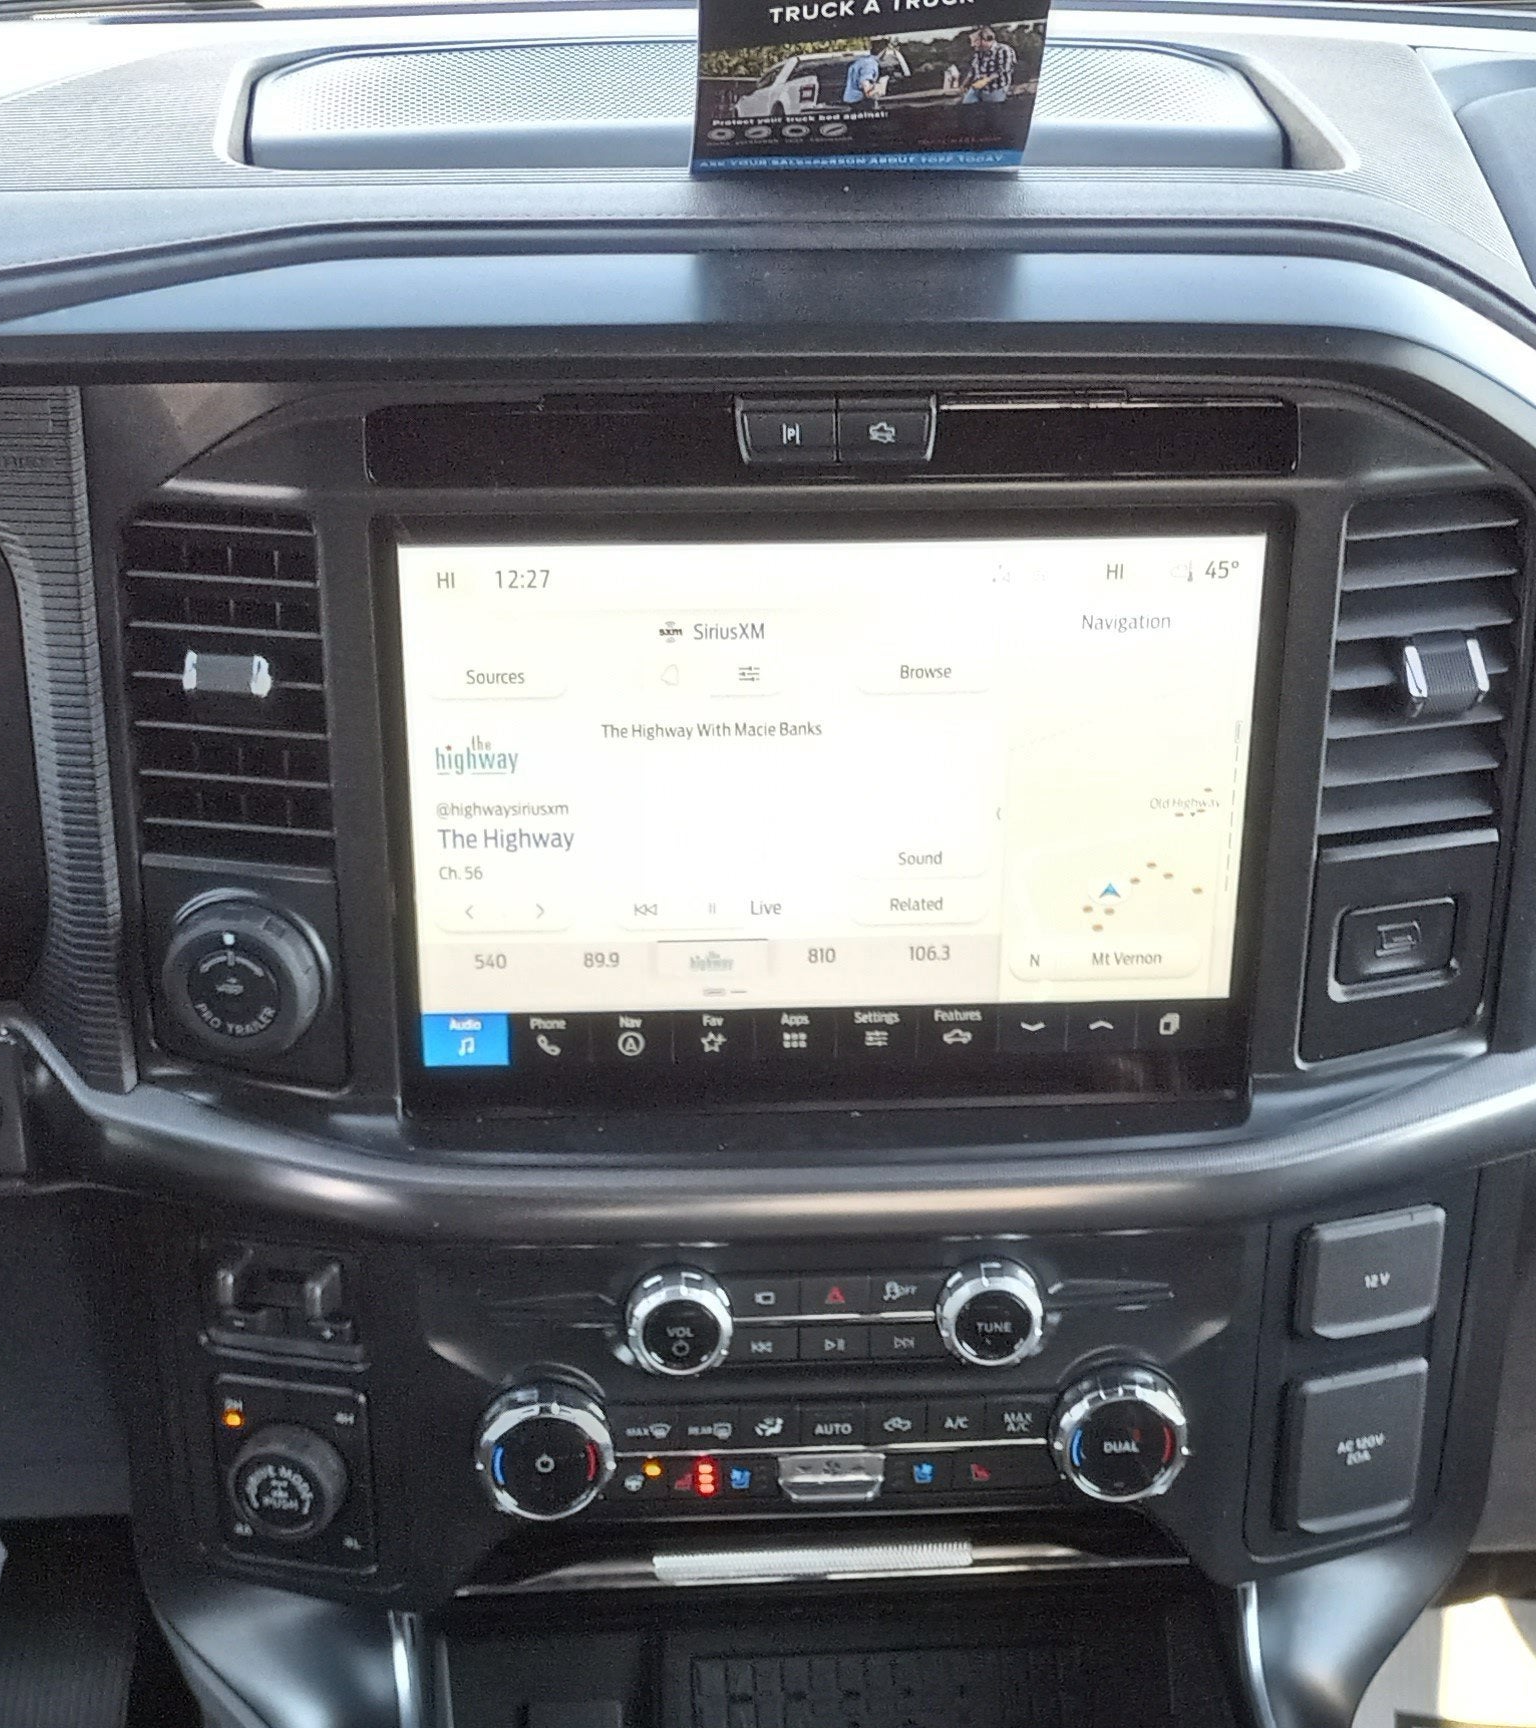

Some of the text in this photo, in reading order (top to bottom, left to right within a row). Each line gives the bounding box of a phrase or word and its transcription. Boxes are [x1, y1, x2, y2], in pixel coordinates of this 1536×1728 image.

[769, 0, 856, 24] TRUCK
[863, 0, 881, 15] A
[711, 118, 755, 128] Protect
[757, 116, 782, 125] your
[786, 115, 814, 124] truck
[1105, 560, 1241, 580] HI 45°
[436, 569, 551, 589] HI 12:27
[1081, 613, 1172, 633] Navigation
[693, 623, 766, 642] SiriusXM
[465, 669, 525, 685] Sources
[899, 664, 952, 681] Browse
[601, 721, 822, 741] The Highway With Macie Banks
[435, 746, 519, 775] highway
[436, 802, 569, 820] @highwaysiriusxm
[437, 828, 575, 853] The Highway
[898, 850, 943, 867] Sound
[439, 866, 484, 881] Ch. 56
[750, 900, 783, 916] Live
[890, 897, 943, 913] Related
[583, 952, 620, 969] 89.9
[807, 947, 837, 964] 810
[908, 945, 951, 962] 106.3
[1113, 951, 1163, 967] Vernon
[474, 954, 507, 970] 540
[529, 1016, 567, 1030] Phone
[619, 1015, 643, 1029] Nav
[702, 1014, 724, 1027] Fav
[781, 1012, 810, 1027] Apps
[854, 1010, 900, 1026] Settings
[934, 1008, 983, 1023] Features
[448, 1017, 482, 1031] Audio
[666, 1326, 695, 1339] VOL
[976, 1320, 1013, 1334] TUNE
[814, 1422, 852, 1436] AUTO
[944, 1416, 969, 1430] A/C
[1103, 1441, 1140, 1455] DUAL
